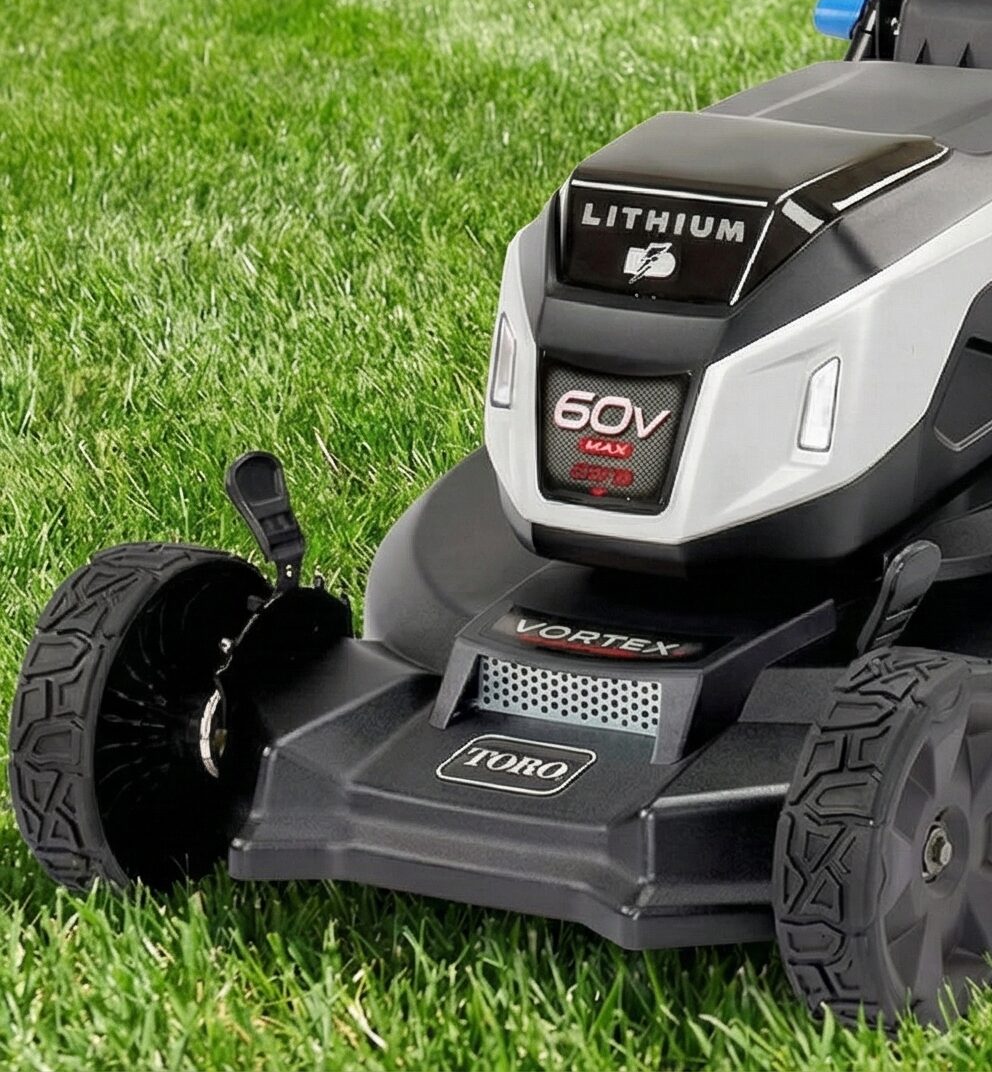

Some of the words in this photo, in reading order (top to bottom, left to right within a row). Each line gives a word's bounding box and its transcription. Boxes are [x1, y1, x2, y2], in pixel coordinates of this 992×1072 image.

[581, 202, 745, 243] LITHIUM
[516, 619, 680, 656] VORTEX
[463, 747, 569, 779] TORO
